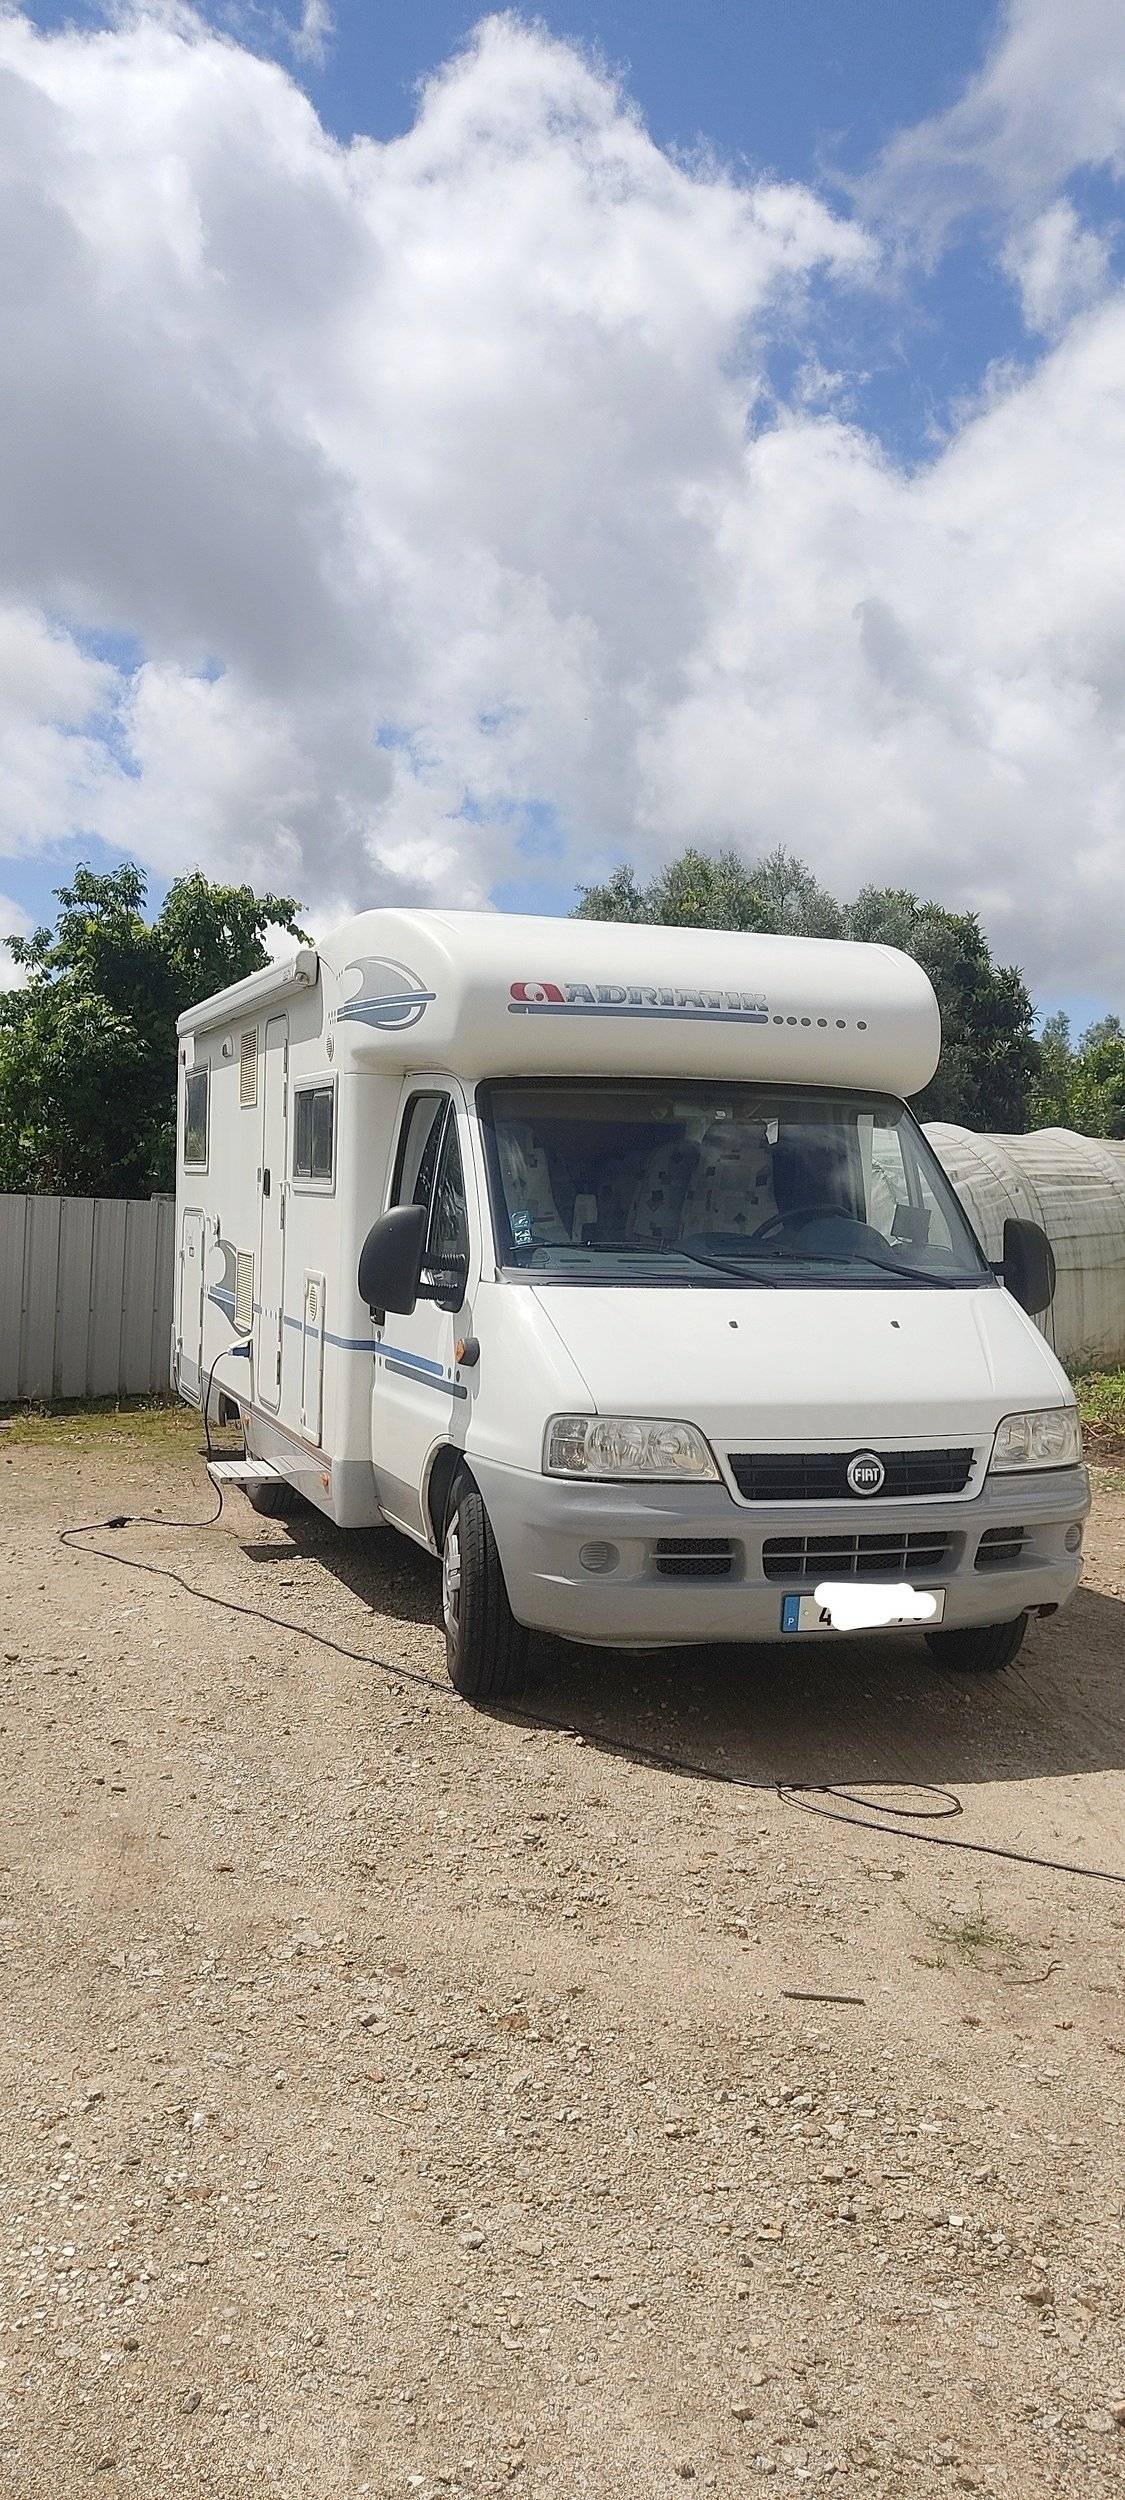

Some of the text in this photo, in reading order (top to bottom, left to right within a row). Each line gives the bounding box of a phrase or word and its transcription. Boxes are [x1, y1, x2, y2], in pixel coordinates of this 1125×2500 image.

[564, 983, 769, 1012] ADRIATIK
[854, 1468, 879, 1482] FIAT
[787, 1617, 795, 1626] P
